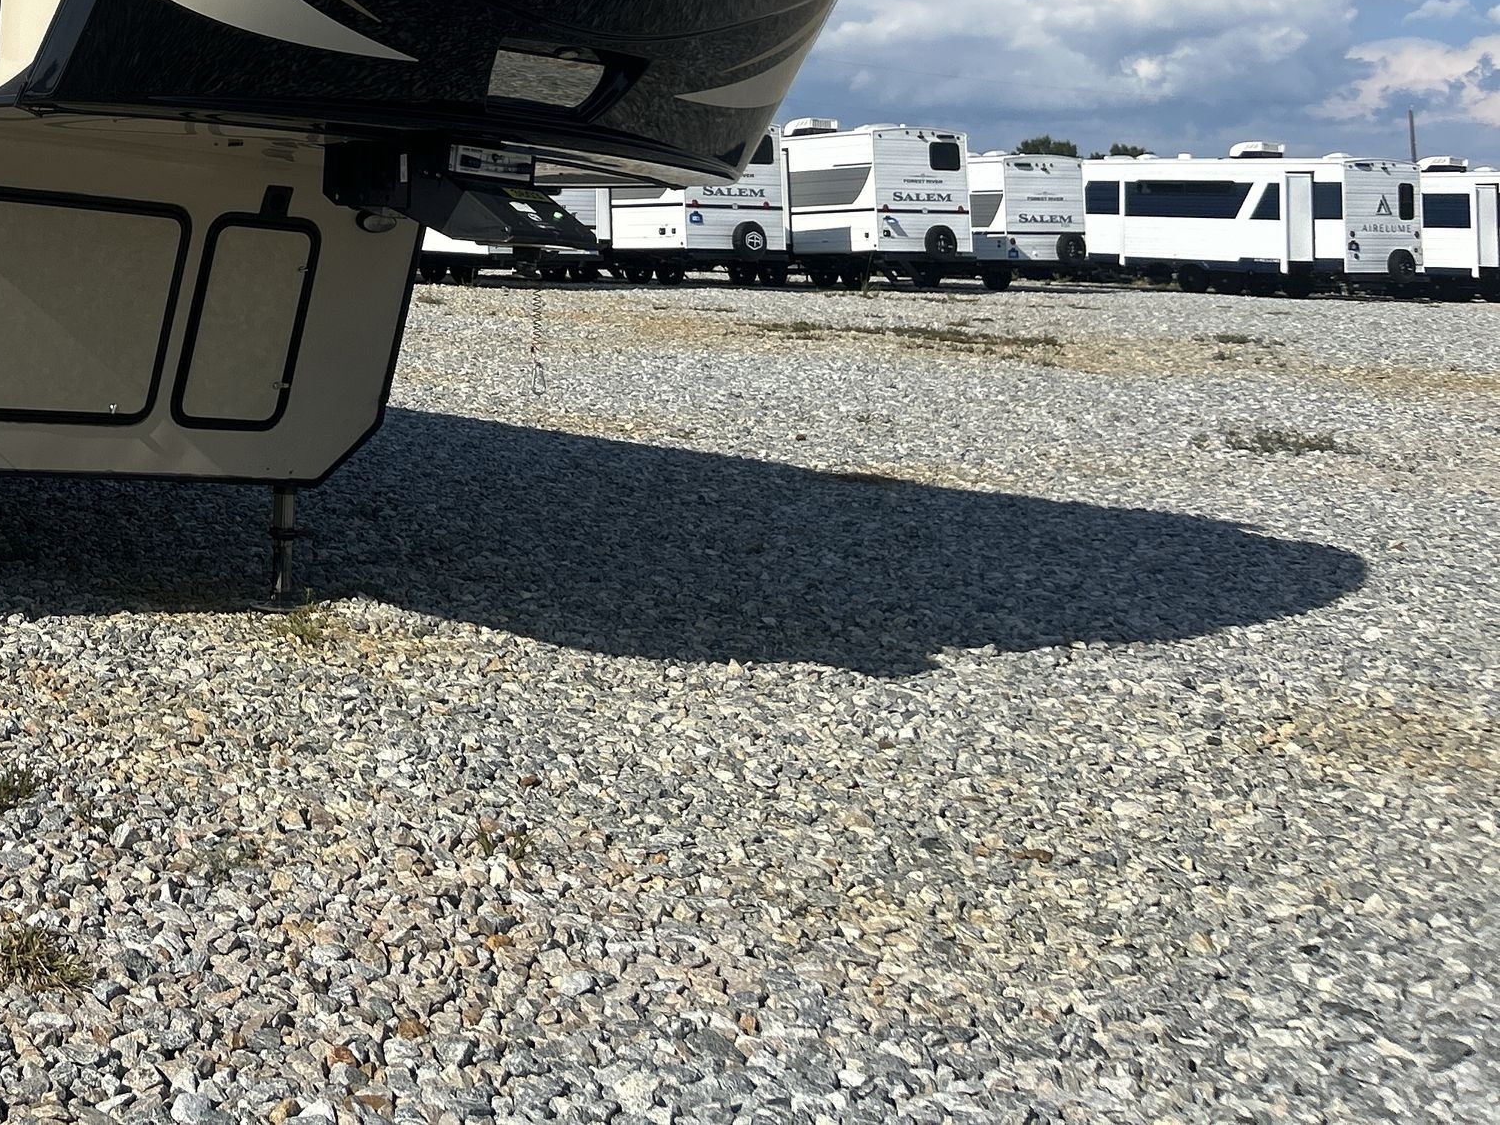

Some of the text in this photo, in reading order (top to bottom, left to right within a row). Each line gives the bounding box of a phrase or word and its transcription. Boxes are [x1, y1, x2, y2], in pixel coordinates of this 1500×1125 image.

[702, 185, 766, 198] SALEM
[892, 191, 953, 202] SALEM
[1018, 213, 1073, 224] SALEM
[1361, 224, 1412, 233] AIRELUME
